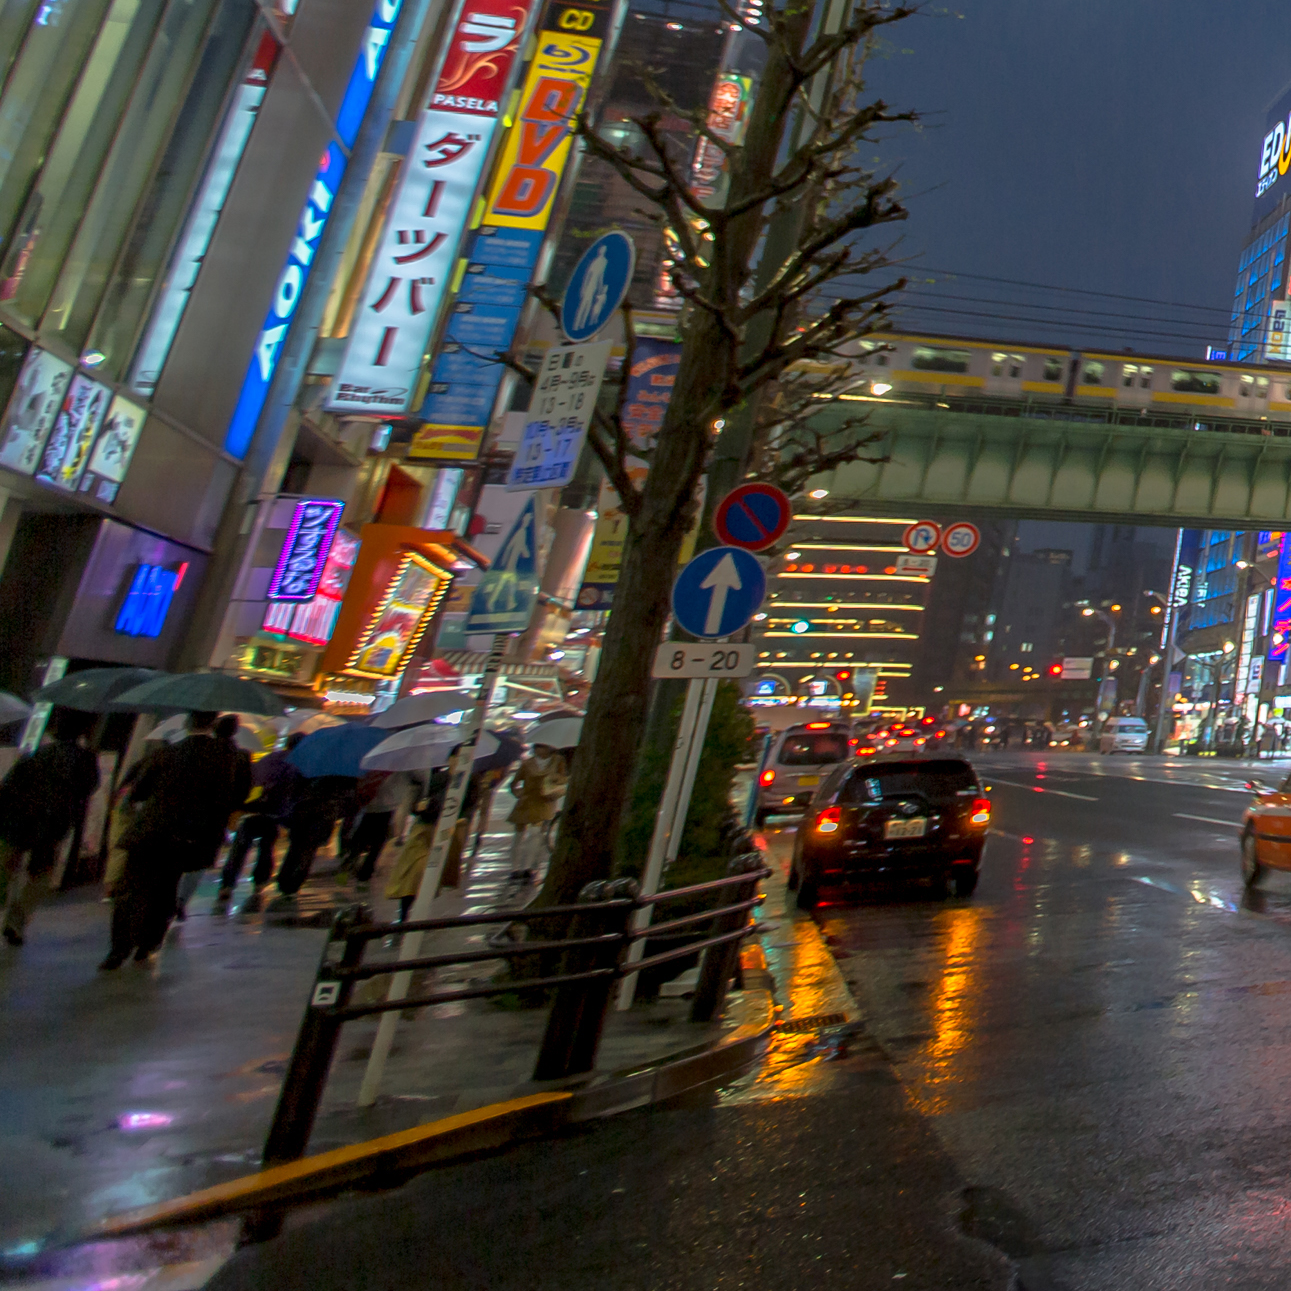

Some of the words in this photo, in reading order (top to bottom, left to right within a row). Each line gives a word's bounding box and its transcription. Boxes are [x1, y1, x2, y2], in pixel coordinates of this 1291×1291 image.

[558, 8, 595, 32] CD
[432, 92, 499, 112] PASELA
[492, 76, 584, 217] DVD
[255, 177, 332, 382] AOKI
[373, 130, 481, 367] ダーツバー
[949, 531, 972, 548] 50
